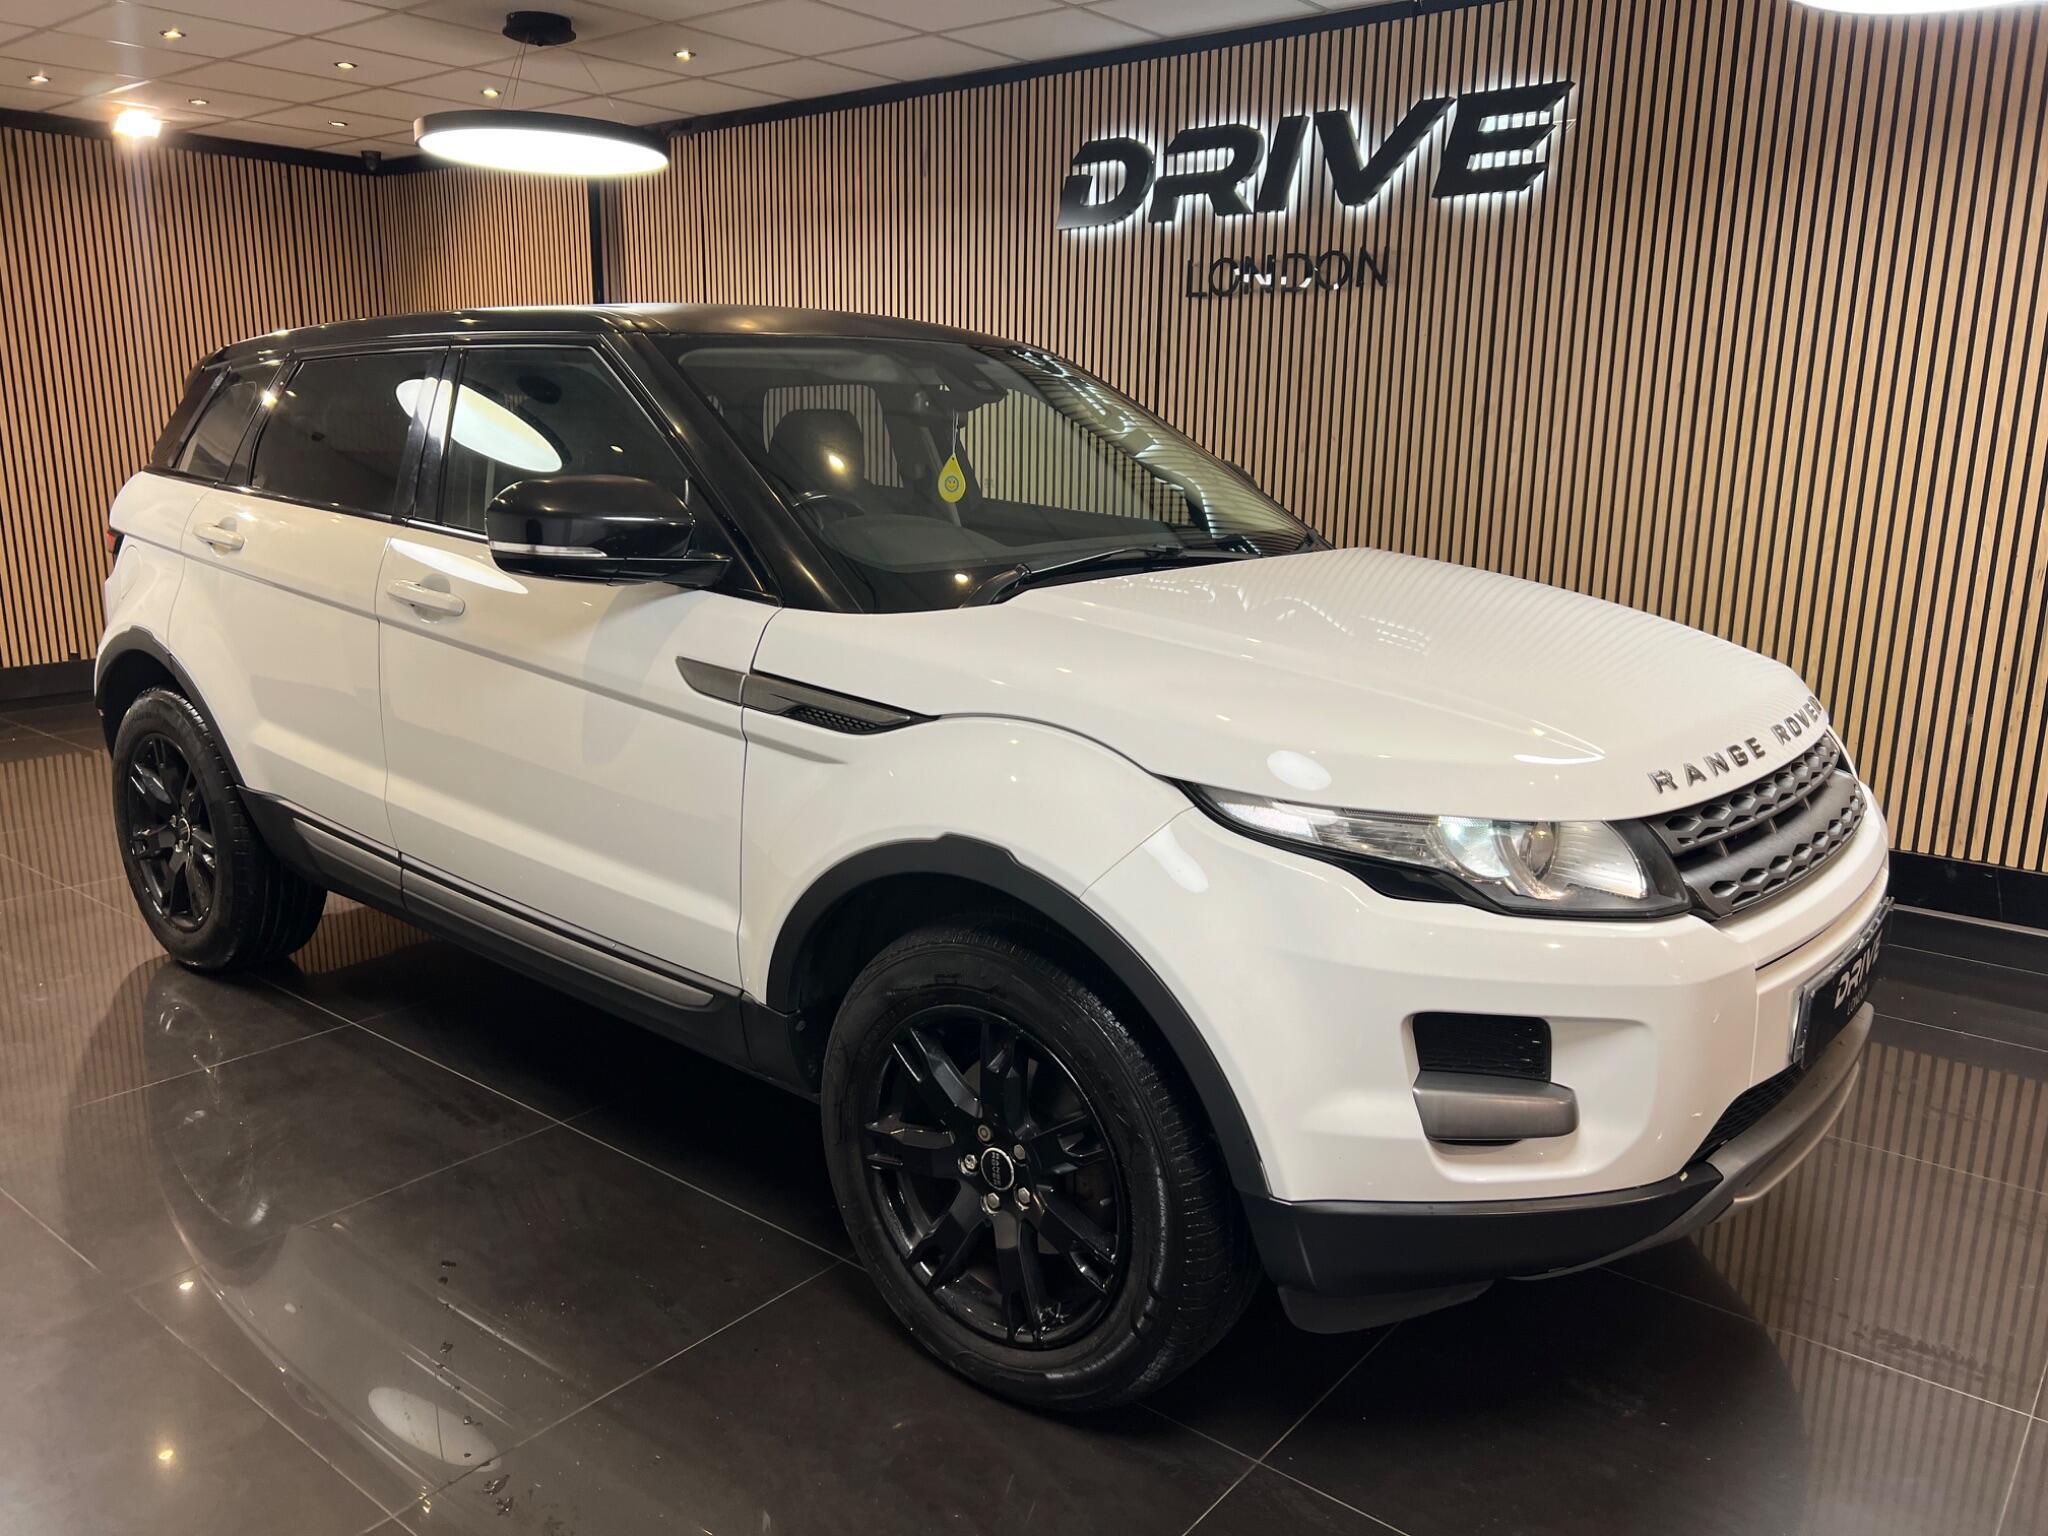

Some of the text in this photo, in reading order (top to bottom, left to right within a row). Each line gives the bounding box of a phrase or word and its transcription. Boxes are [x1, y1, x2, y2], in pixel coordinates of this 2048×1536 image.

[1056, 80, 1576, 230] DRIVE
[1185, 246, 1389, 298] LONDON
[1647, 736, 1767, 794] RANGE
[1834, 928, 1883, 1009] DRIVE
